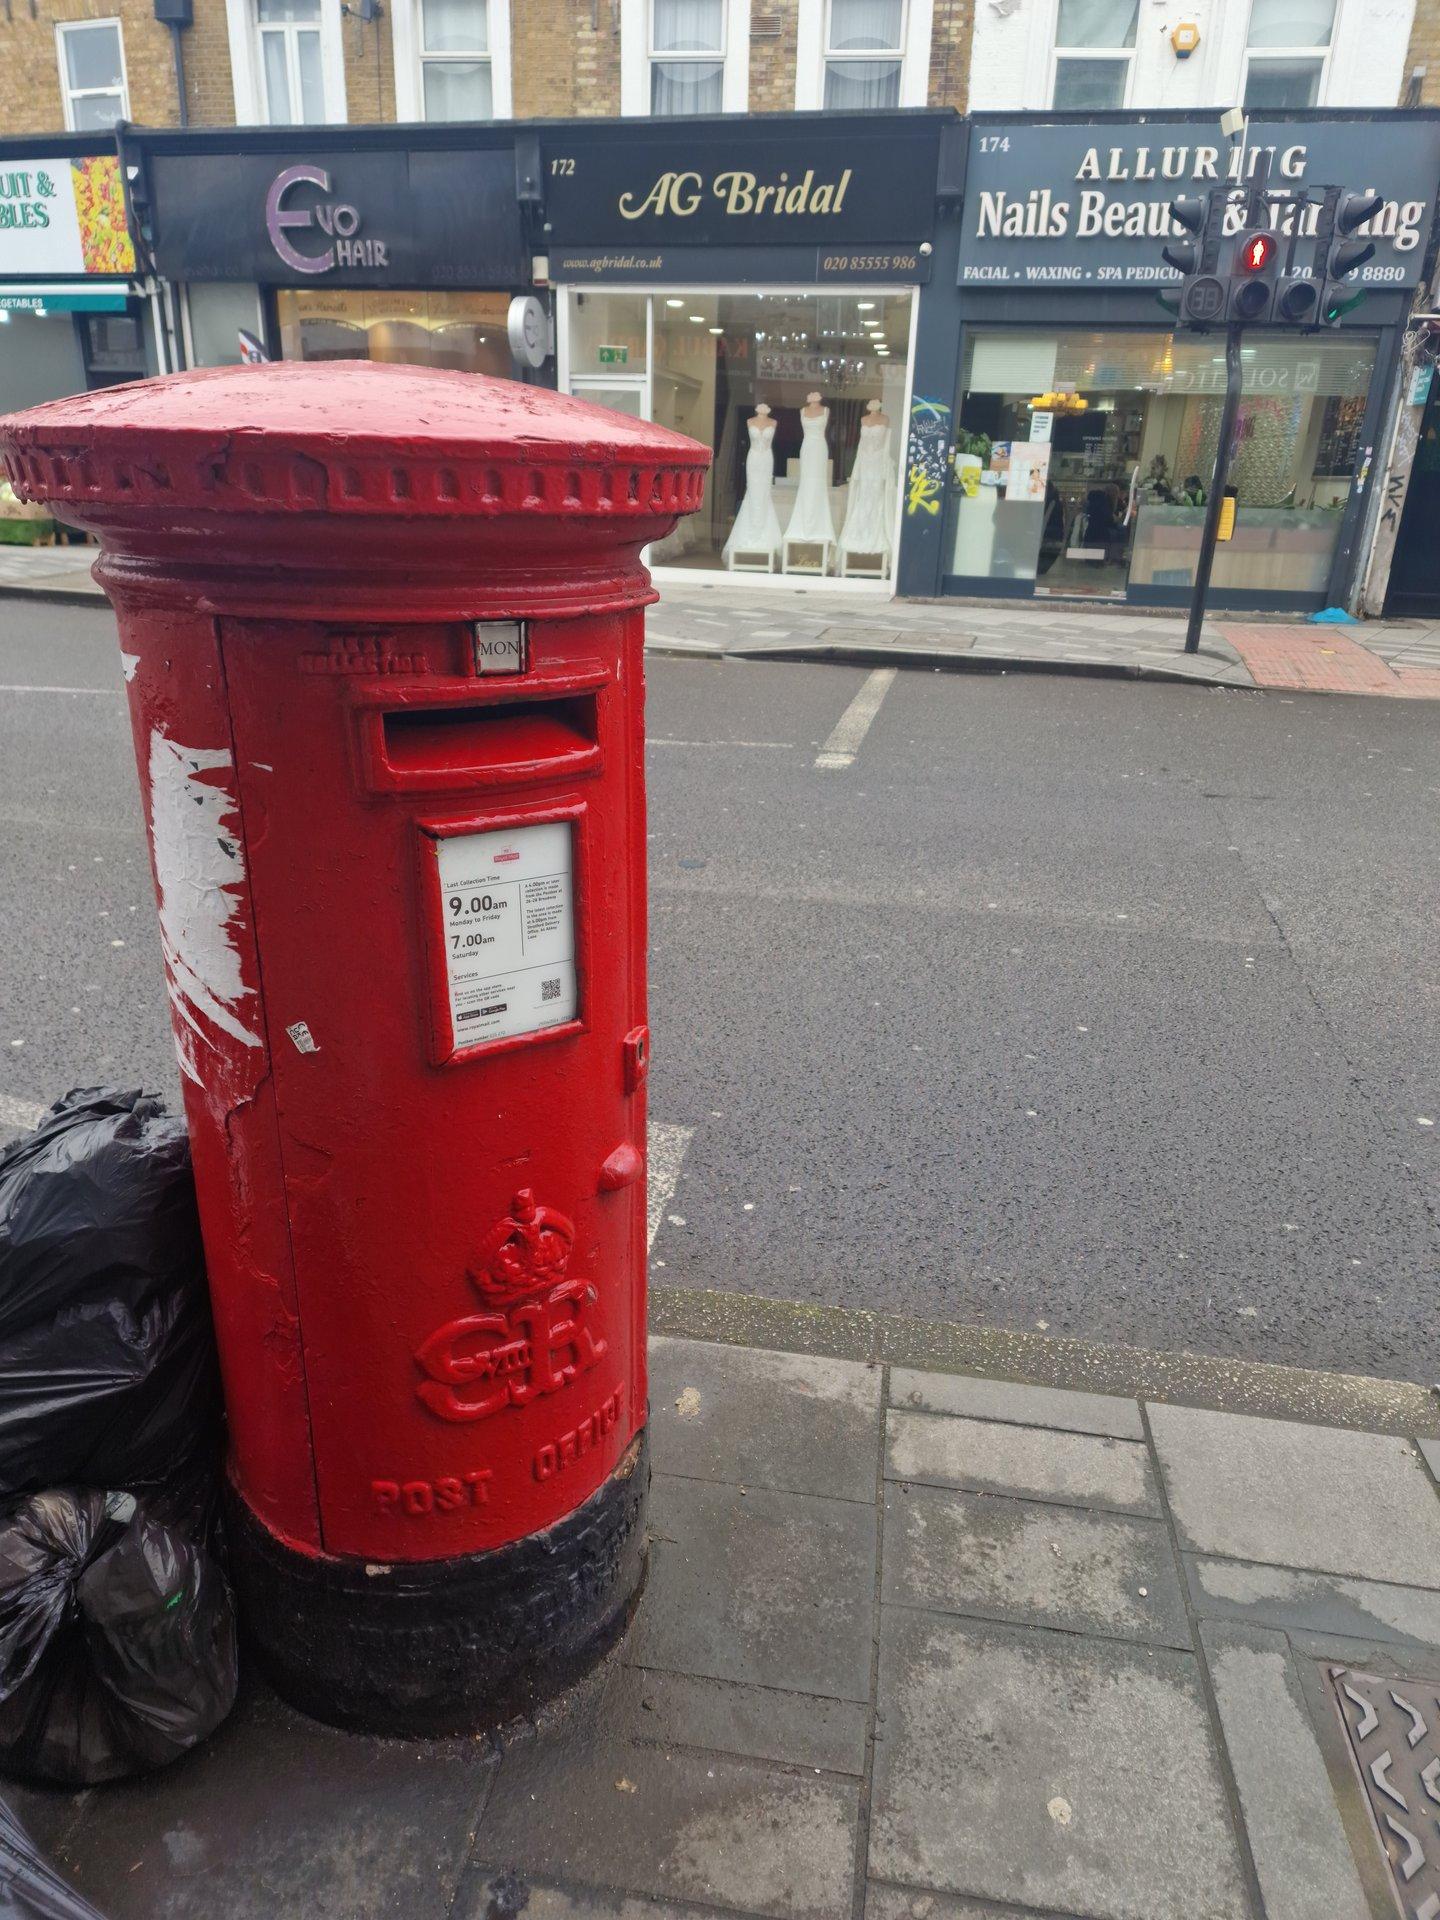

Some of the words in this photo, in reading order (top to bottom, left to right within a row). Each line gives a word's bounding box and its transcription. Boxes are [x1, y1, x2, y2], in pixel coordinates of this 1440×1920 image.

[979, 137, 1010, 152] 174
[551, 159, 575, 176] 172
[1075, 145, 1307, 180] ALLURING
[37, 171, 56, 197] &
[619, 172, 702, 219] AG
[713, 169, 852, 214] Bridal
[976, 189, 1070, 238] Nails
[1075, 188, 1190, 244] Beaut
[1222, 190, 1248, 237] &
[1266, 187, 1426, 251] Taning
[336, 239, 389, 266] HAIR
[563, 255, 662, 273] www.agbridal.co.uk
[823, 256, 848, 270] 020
[849, 256, 891, 270] 85555
[892, 255, 916, 269] 986
[963, 266, 1010, 280] FACIAL
[1026, 266, 1082, 280] WAXING
[1097, 266, 1123, 280] SPA
[1362, 266, 1406, 281] 8880
[480, 641, 520, 656] MON
[460, 878, 486, 886] Collection
[449, 895, 507, 917] 9.00am
[450, 919, 473, 927] Monday
[451, 934, 495, 949] 7.00am
[452, 951, 479, 960] Saturday
[453, 971, 479, 980] Services
[371, 1468, 493, 1514] POST
